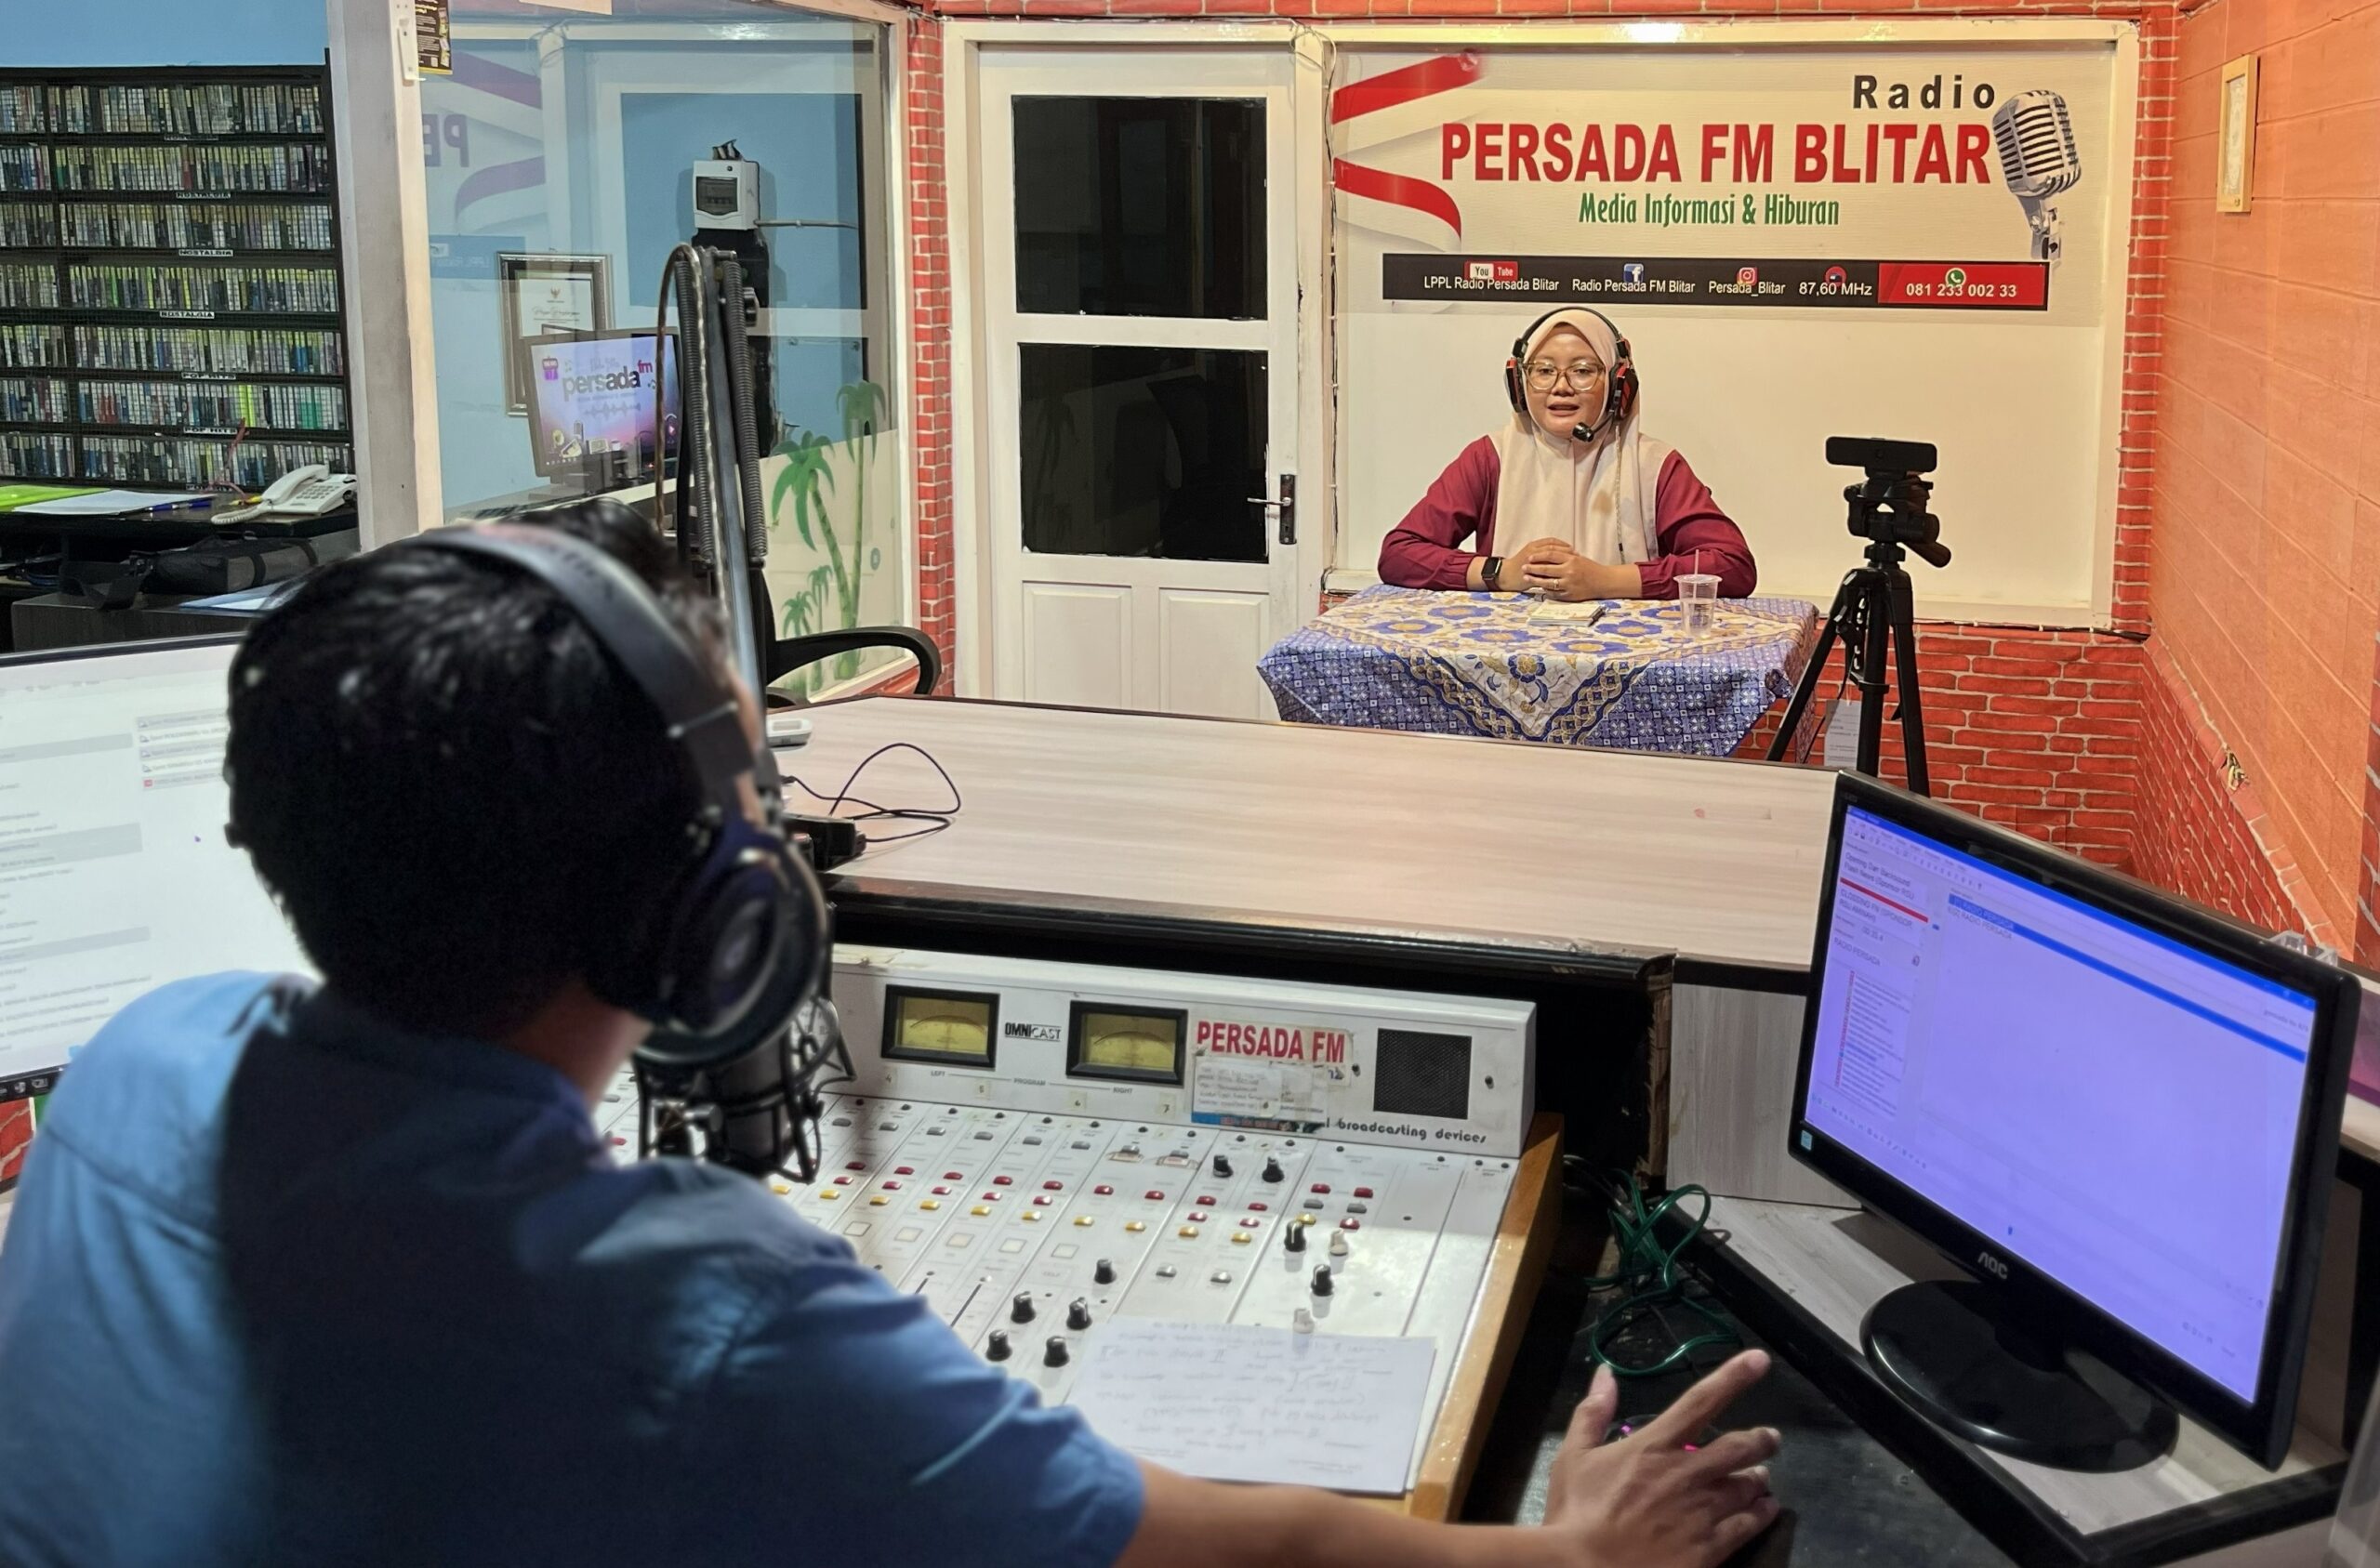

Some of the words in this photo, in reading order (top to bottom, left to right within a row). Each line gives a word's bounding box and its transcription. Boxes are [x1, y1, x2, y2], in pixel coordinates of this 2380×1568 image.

[1853, 74, 1995, 109] Radio
[1441, 123, 1683, 183] PERSADA
[1700, 124, 1774, 183] FM
[1794, 124, 1991, 184] BLITAR
[1579, 192, 1636, 223] Media
[1645, 193, 1736, 228] Informasi
[1741, 193, 1756, 224] &
[1765, 193, 1840, 225] Hiburan
[1474, 266, 1489, 276] You
[1423, 276, 1452, 290] LPPL
[1454, 277, 1485, 290] Radio
[1488, 277, 1530, 291] Persada
[1532, 278, 1560, 291] Blitar
[1572, 278, 1602, 292] Radio
[1604, 279, 1646, 293] Persada
[1649, 280, 1666, 293] FM
[1669, 280, 1696, 294] Blitar
[1708, 281, 1786, 297] Persada_Blitar
[1798, 283, 1837, 296] 87,60
[1841, 283, 1872, 296] MHz
[1906, 283, 1931, 296] 081
[1937, 283, 1964, 297] 233
[1968, 284, 1994, 297] 002
[1999, 284, 2017, 297] 33
[562, 365, 641, 402] persada
[637, 359, 654, 374] fm
[1004, 1021, 1062, 1041] OMNICAST
[1197, 1020, 1304, 1061] PERSADA
[1312, 1030, 1345, 1063] FM
[1013, 1077, 1046, 1086] PROGRAM
[1337, 1117, 1428, 1141] broadcasting
[1435, 1127, 1488, 1144] devices
[1977, 1250, 2008, 1280] AOC
